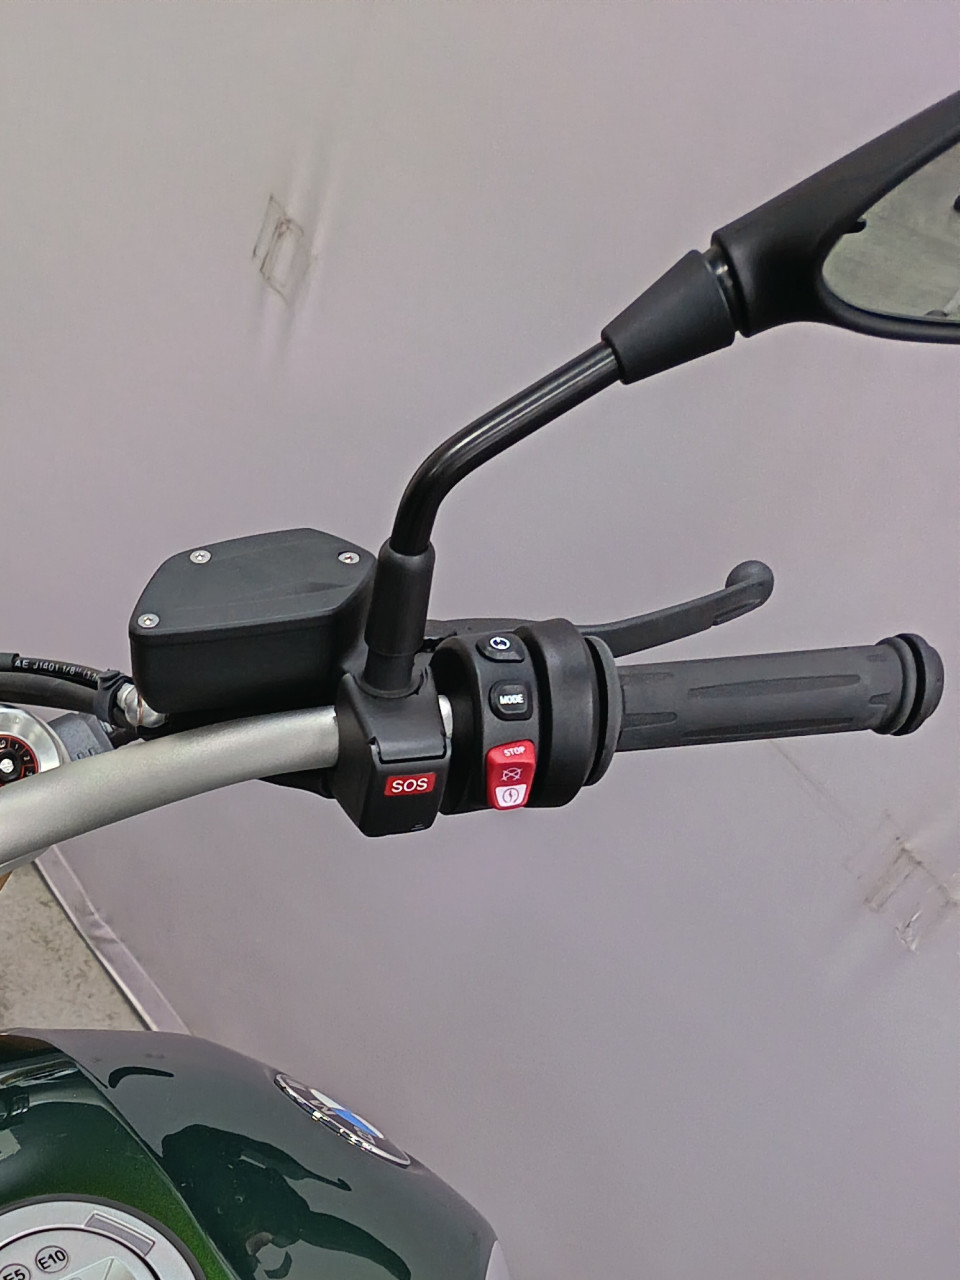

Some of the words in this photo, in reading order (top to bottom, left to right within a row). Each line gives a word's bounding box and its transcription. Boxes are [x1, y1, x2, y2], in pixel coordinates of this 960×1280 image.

[499, 694, 524, 705] MODE
[503, 747, 525, 757] STOP
[391, 777, 429, 793] SOS
[38, 1250, 66, 1270] E10
